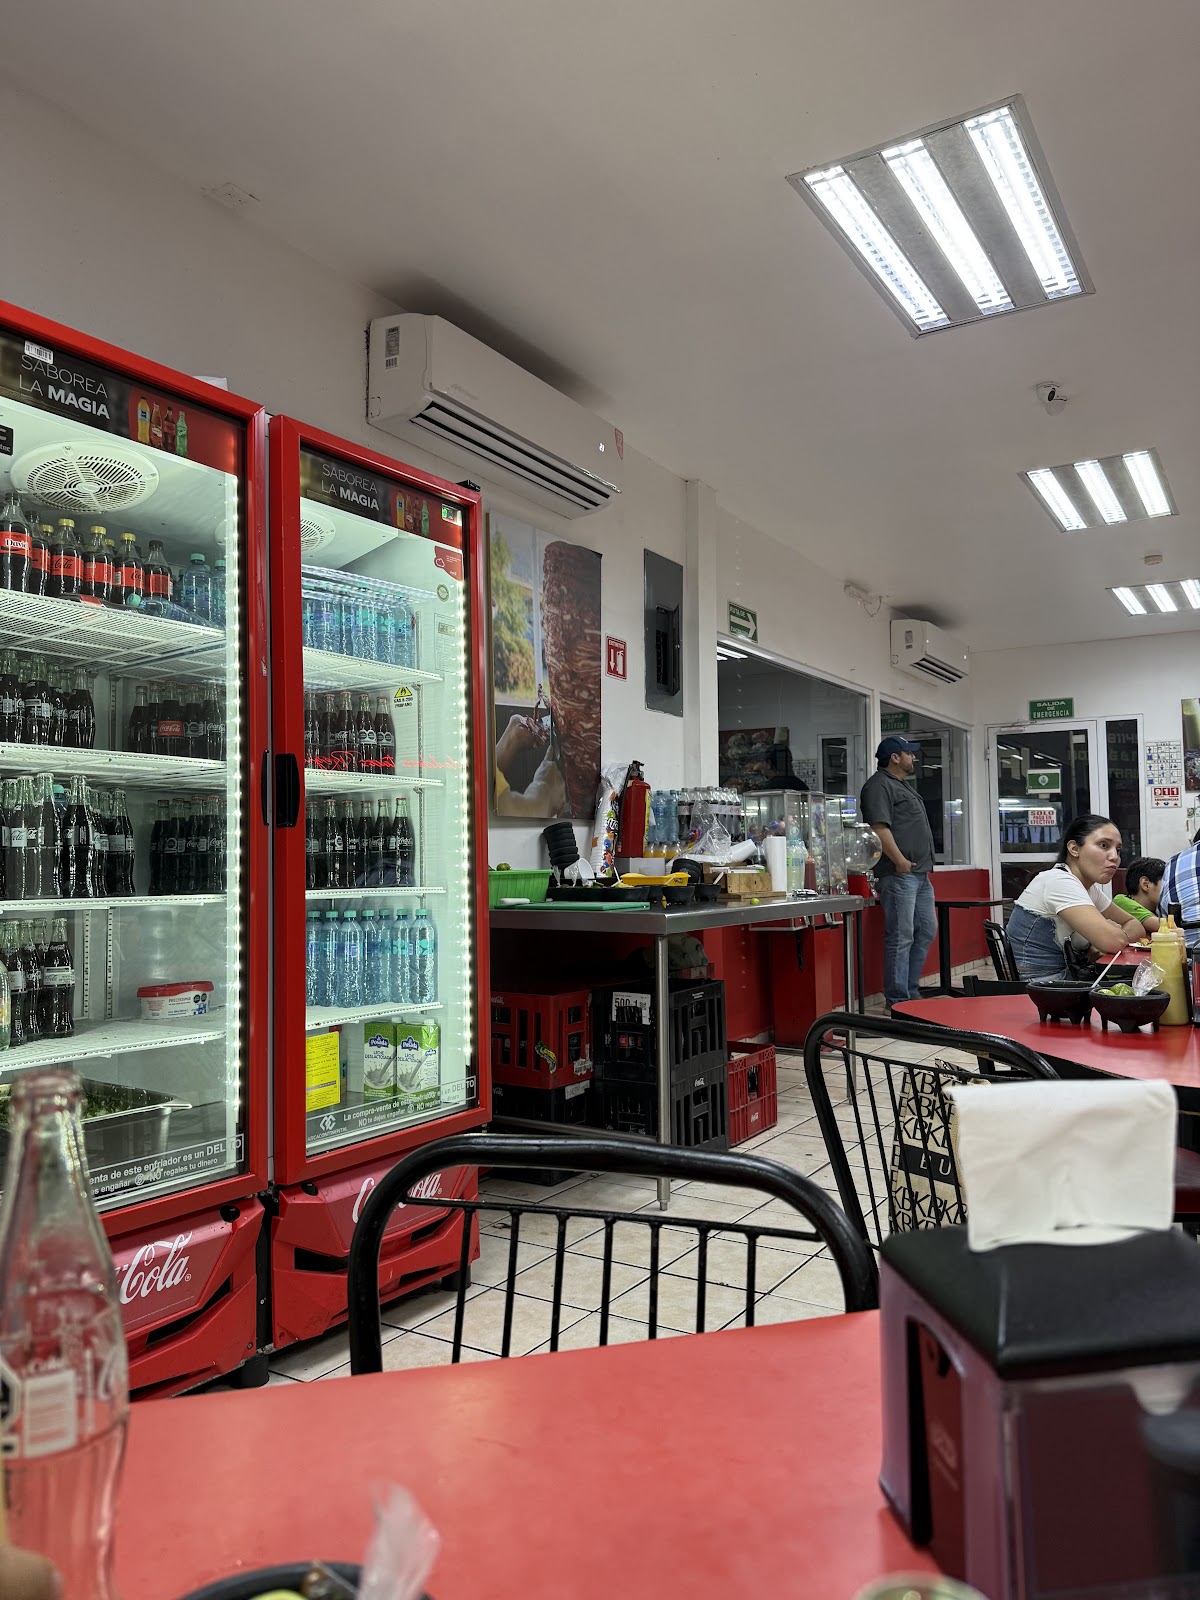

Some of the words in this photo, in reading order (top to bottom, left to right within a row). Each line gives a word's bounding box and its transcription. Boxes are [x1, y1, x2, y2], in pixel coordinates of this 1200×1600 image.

[21, 354, 108, 399] SABOREA
[19, 374, 44, 397] LA
[47, 384, 110, 420] MAGIA
[321, 479, 338, 497] LA
[339, 486, 380, 511] MAGIA
[322, 463, 378, 494] SABOREA
[1033, 709, 1070, 719] EMERGENCIA
[1154, 788, 1179, 796] 911
[343, 1114, 351, 1122] La
[352, 1103, 392, 1119] compra-venta
[392, 1100, 399, 1108] de
[452, 1079, 475, 1091] DELTO
[358, 1118, 367, 1128] NO
[417, 1102, 425, 1111] NO
[89, 1173, 109, 1186] enta
[110, 1169, 122, 1180] de
[123, 1165, 142, 1177] este
[144, 1153, 182, 1172] enfriador
[183, 1153, 193, 1162] es
[194, 1150, 205, 1160] un
[206, 1138, 242, 1156] DELTO
[91, 1188, 100, 1196] es
[100, 1179, 131, 1193] engañar
[149, 1170, 162, 1182] NO
[163, 1164, 188, 1177] regales
[189, 1162, 197, 1170] tu
[197, 1157, 218, 1169] dinero
